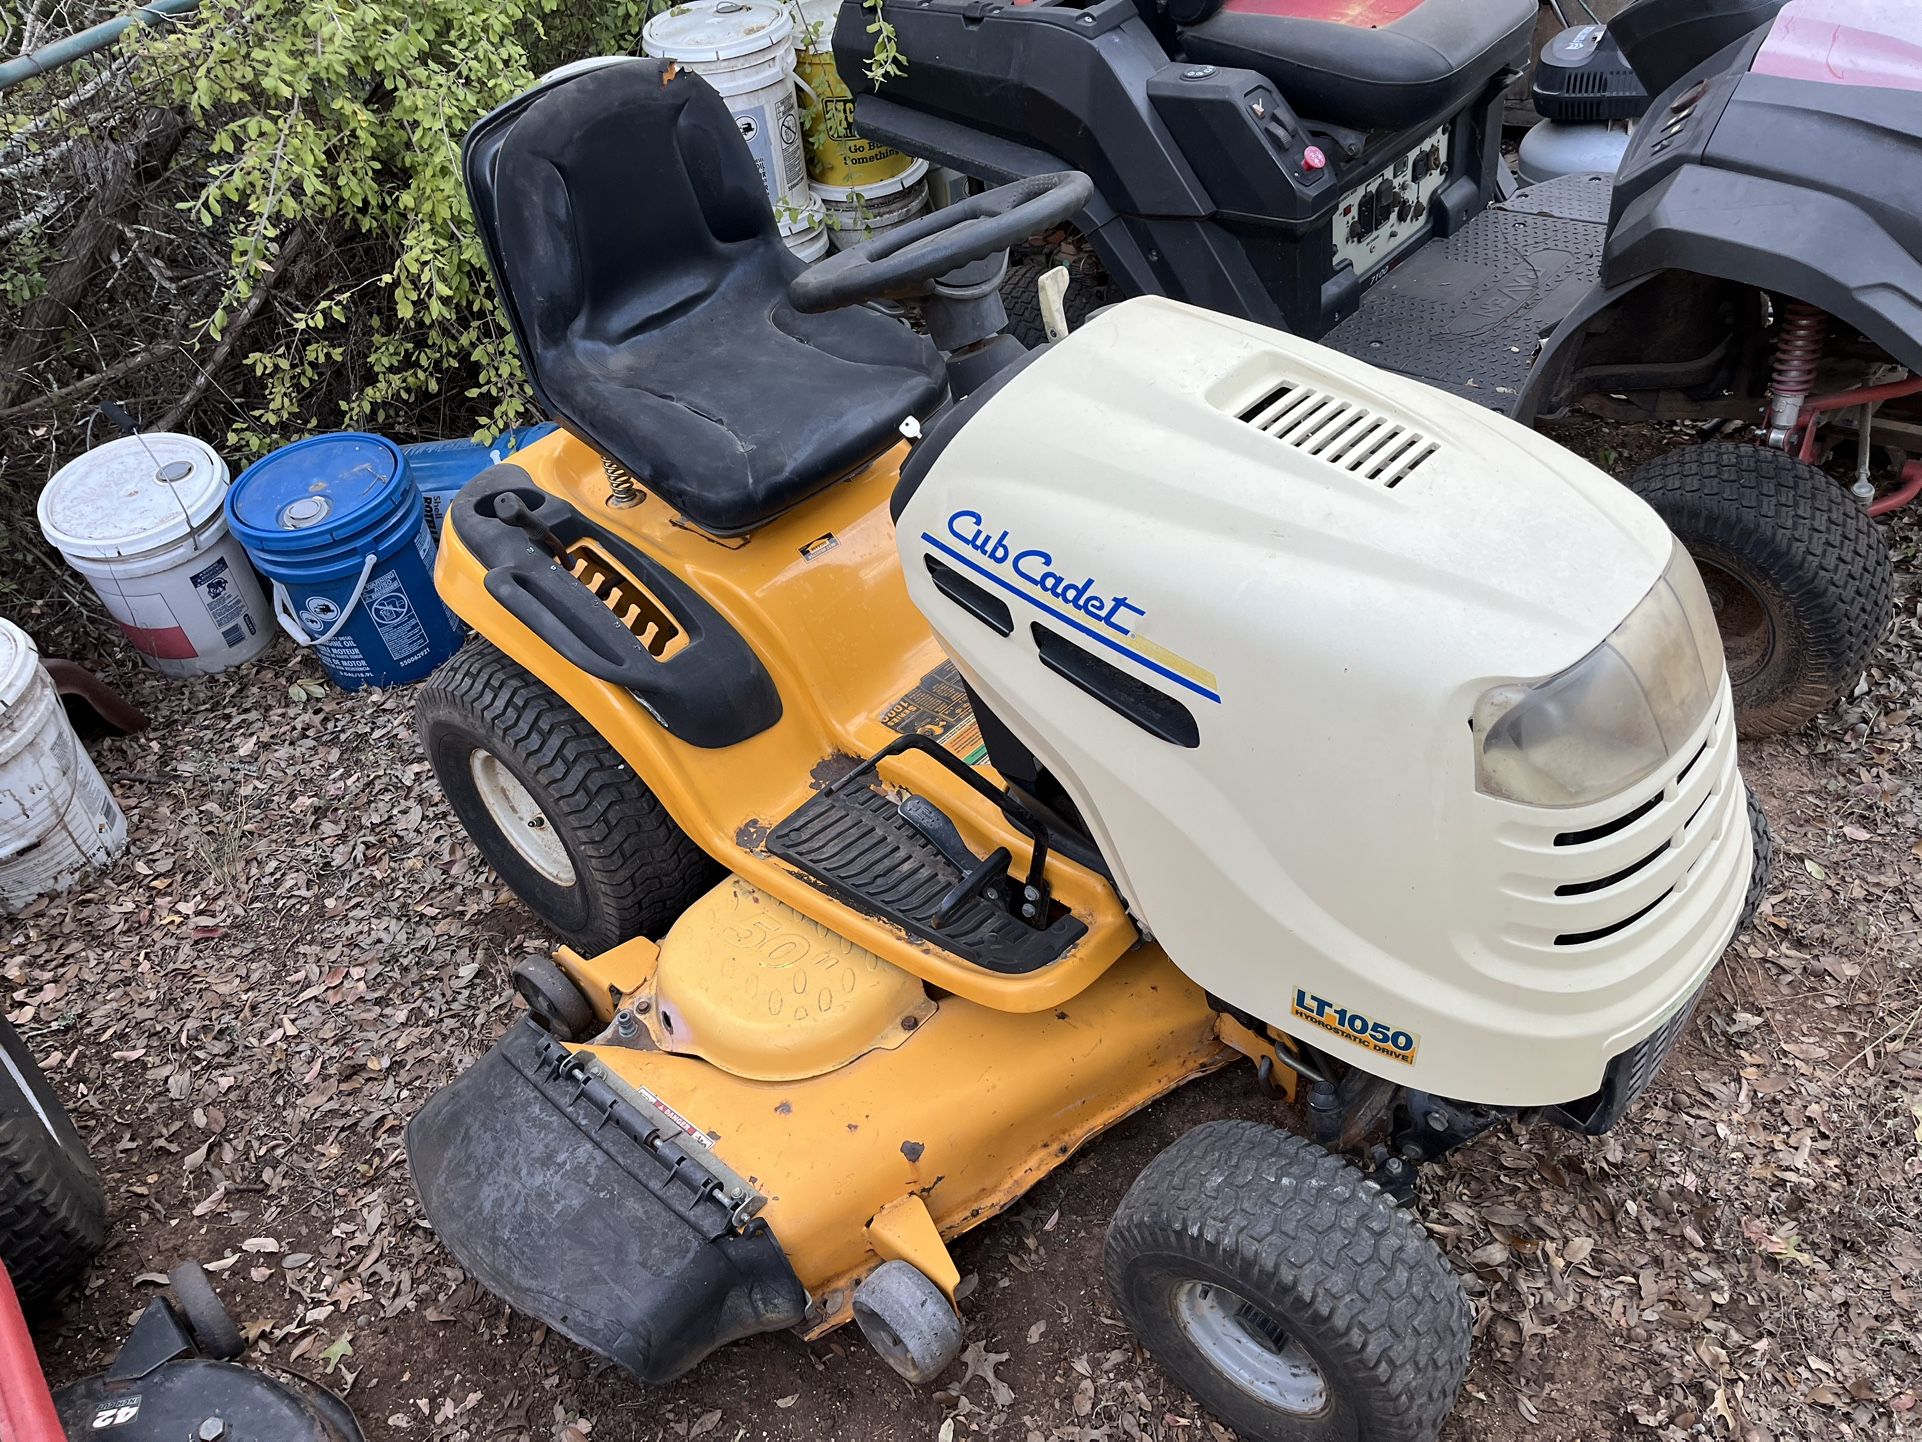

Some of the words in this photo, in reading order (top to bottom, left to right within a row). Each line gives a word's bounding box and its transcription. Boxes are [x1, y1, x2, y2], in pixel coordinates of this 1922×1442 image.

[848, 144, 865, 153] Go
[433, 495, 443, 519] Shell
[947, 510, 1010, 564] Cub
[1012, 549, 1147, 636] Cadet
[1296, 988, 1414, 1052] LT1050
[1295, 1008, 1371, 1048] HYDROSTATIC
[1373, 1044, 1410, 1062] DRIVE
[664, 1108, 691, 1131] DANGER
[92, 1406, 139, 1428] 42
